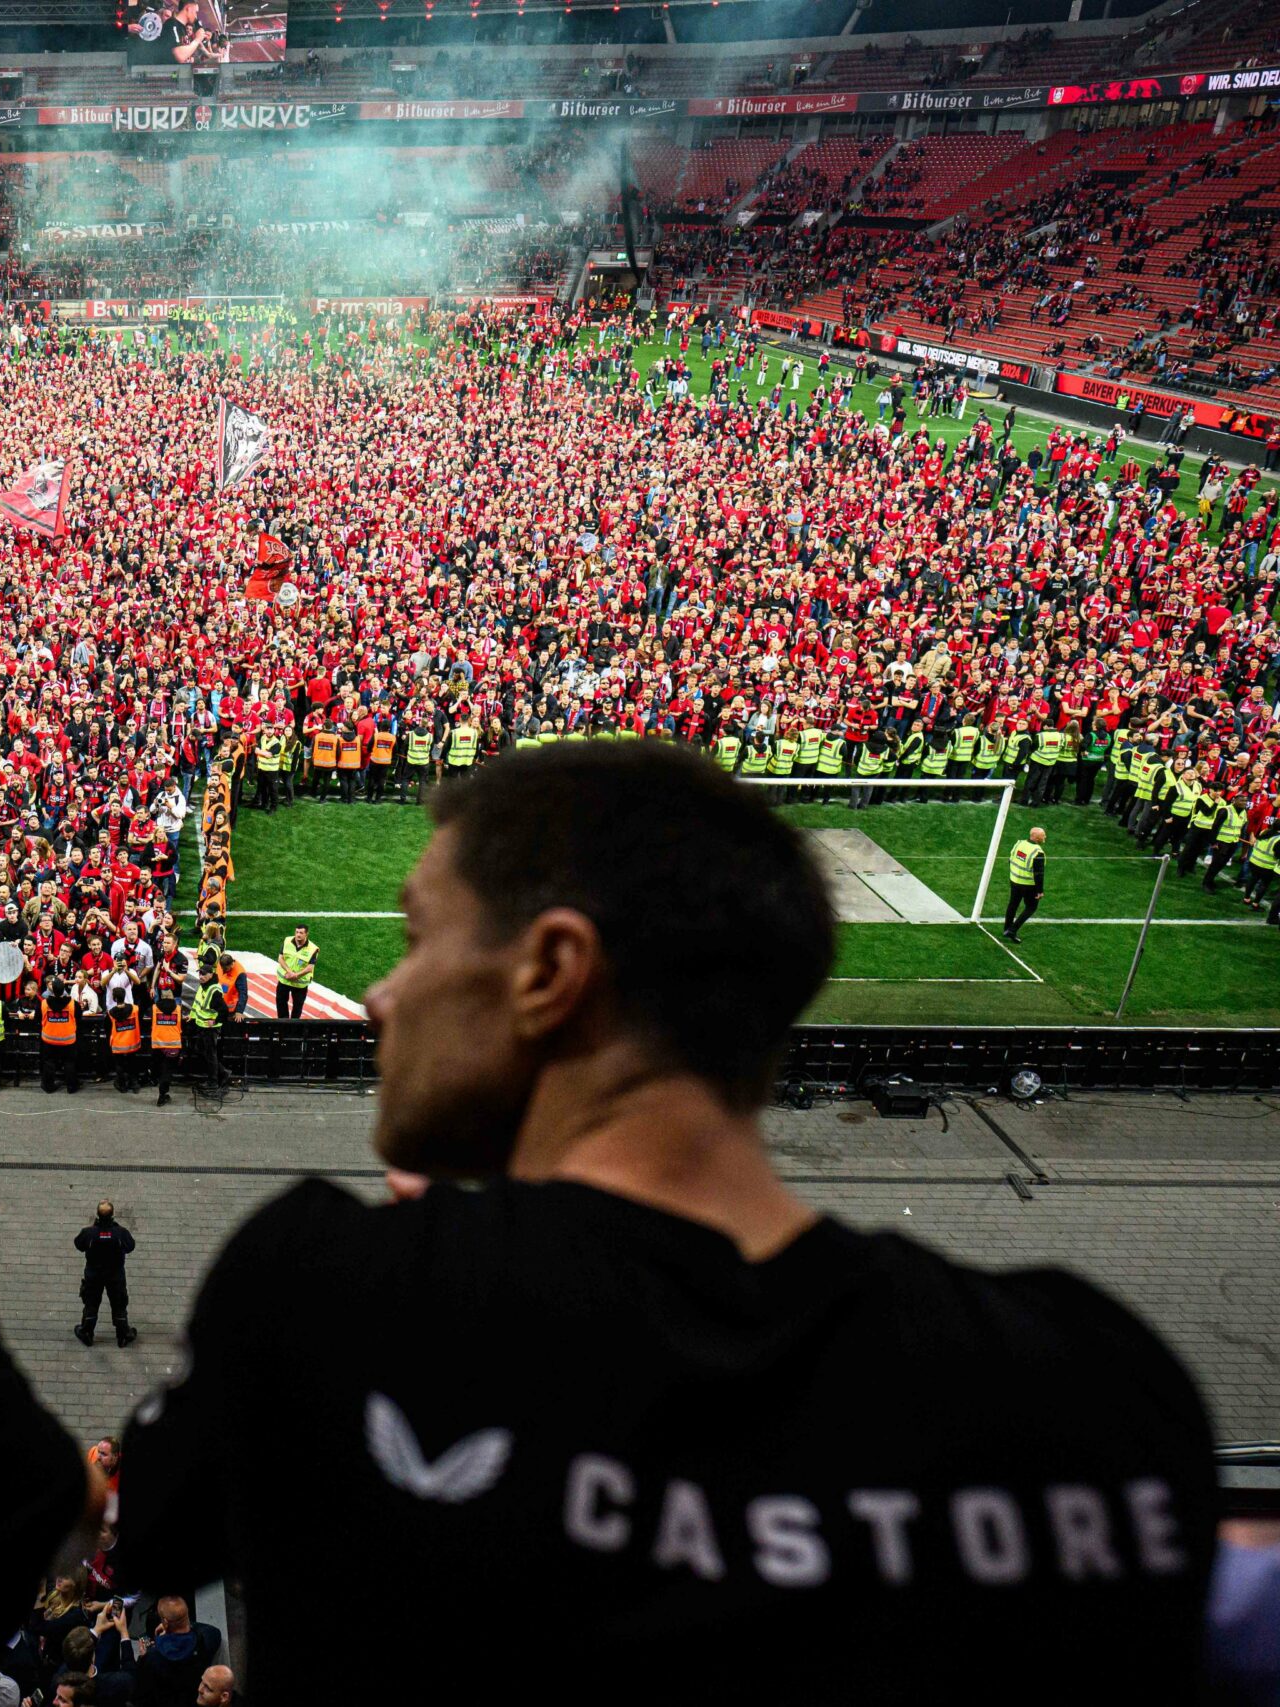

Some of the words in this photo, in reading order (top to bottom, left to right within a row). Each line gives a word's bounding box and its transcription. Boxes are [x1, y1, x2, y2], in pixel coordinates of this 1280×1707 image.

[1208, 75, 1230, 90] WIR.
[1233, 72, 1259, 88] SIND
[831, 95, 846, 104] Bit
[902, 92, 972, 109] Bitburger
[1006, 94, 1022, 102] ein
[1024, 89, 1041, 99] Bit
[332, 103, 346, 113] Bit
[396, 103, 455, 118] Bitburger
[561, 101, 620, 116] Bitburger
[662, 100, 676, 109] Bit
[726, 99, 786, 114] Bitburger
[7, 109, 20, 119] Bit
[71, 108, 112, 123] Bitbur
[221, 105, 310, 128] KURVE
[196, 121, 209, 131] 04
[1000, 363, 1021, 380] 2024
[1082, 381, 1113, 400] BAYER
[562, 1451, 1187, 1588] CASTORE
